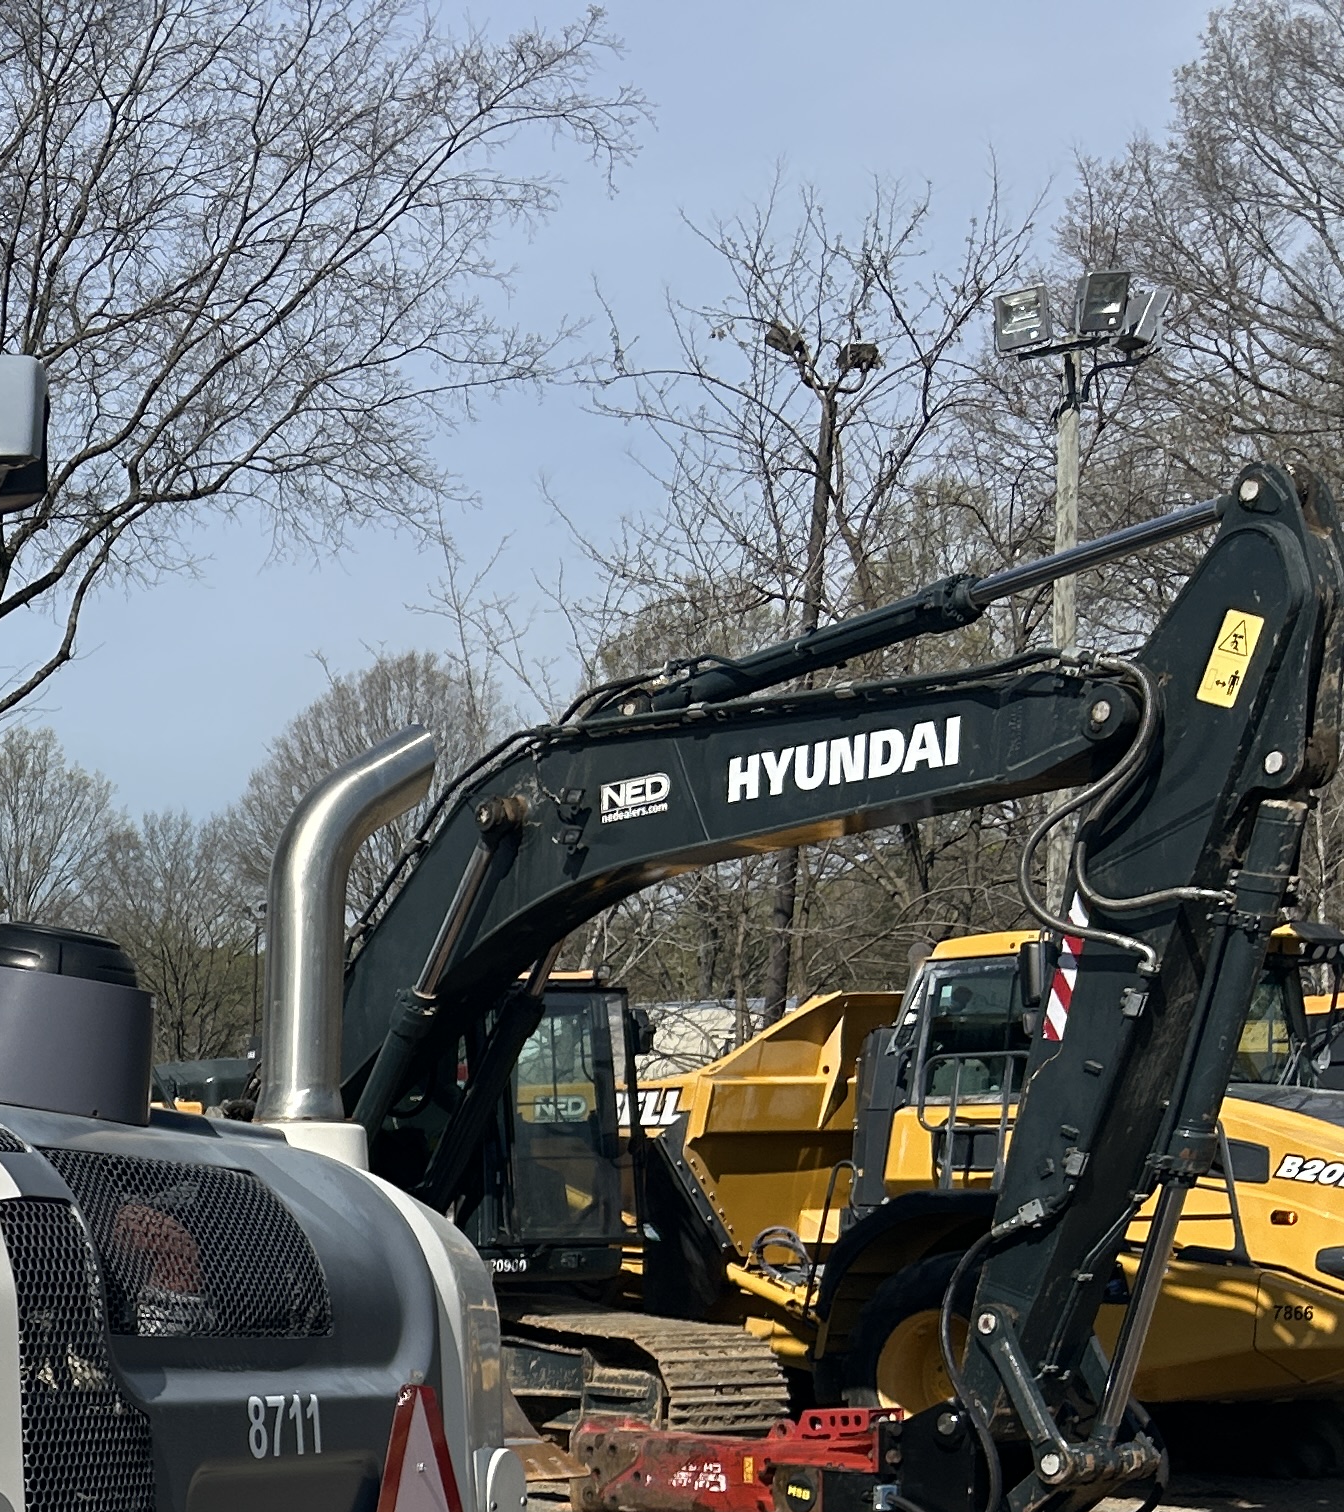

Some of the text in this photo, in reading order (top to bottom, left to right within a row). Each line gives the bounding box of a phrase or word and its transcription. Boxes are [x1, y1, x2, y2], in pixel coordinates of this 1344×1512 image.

[727, 714, 962, 804] HYUNDAI
[602, 776, 668, 811] NED
[601, 803, 669, 824] nedealers.com
[616, 1090, 682, 1126] ELL
[1273, 1304, 1314, 1321] 7866
[247, 1393, 322, 1460] 8711
